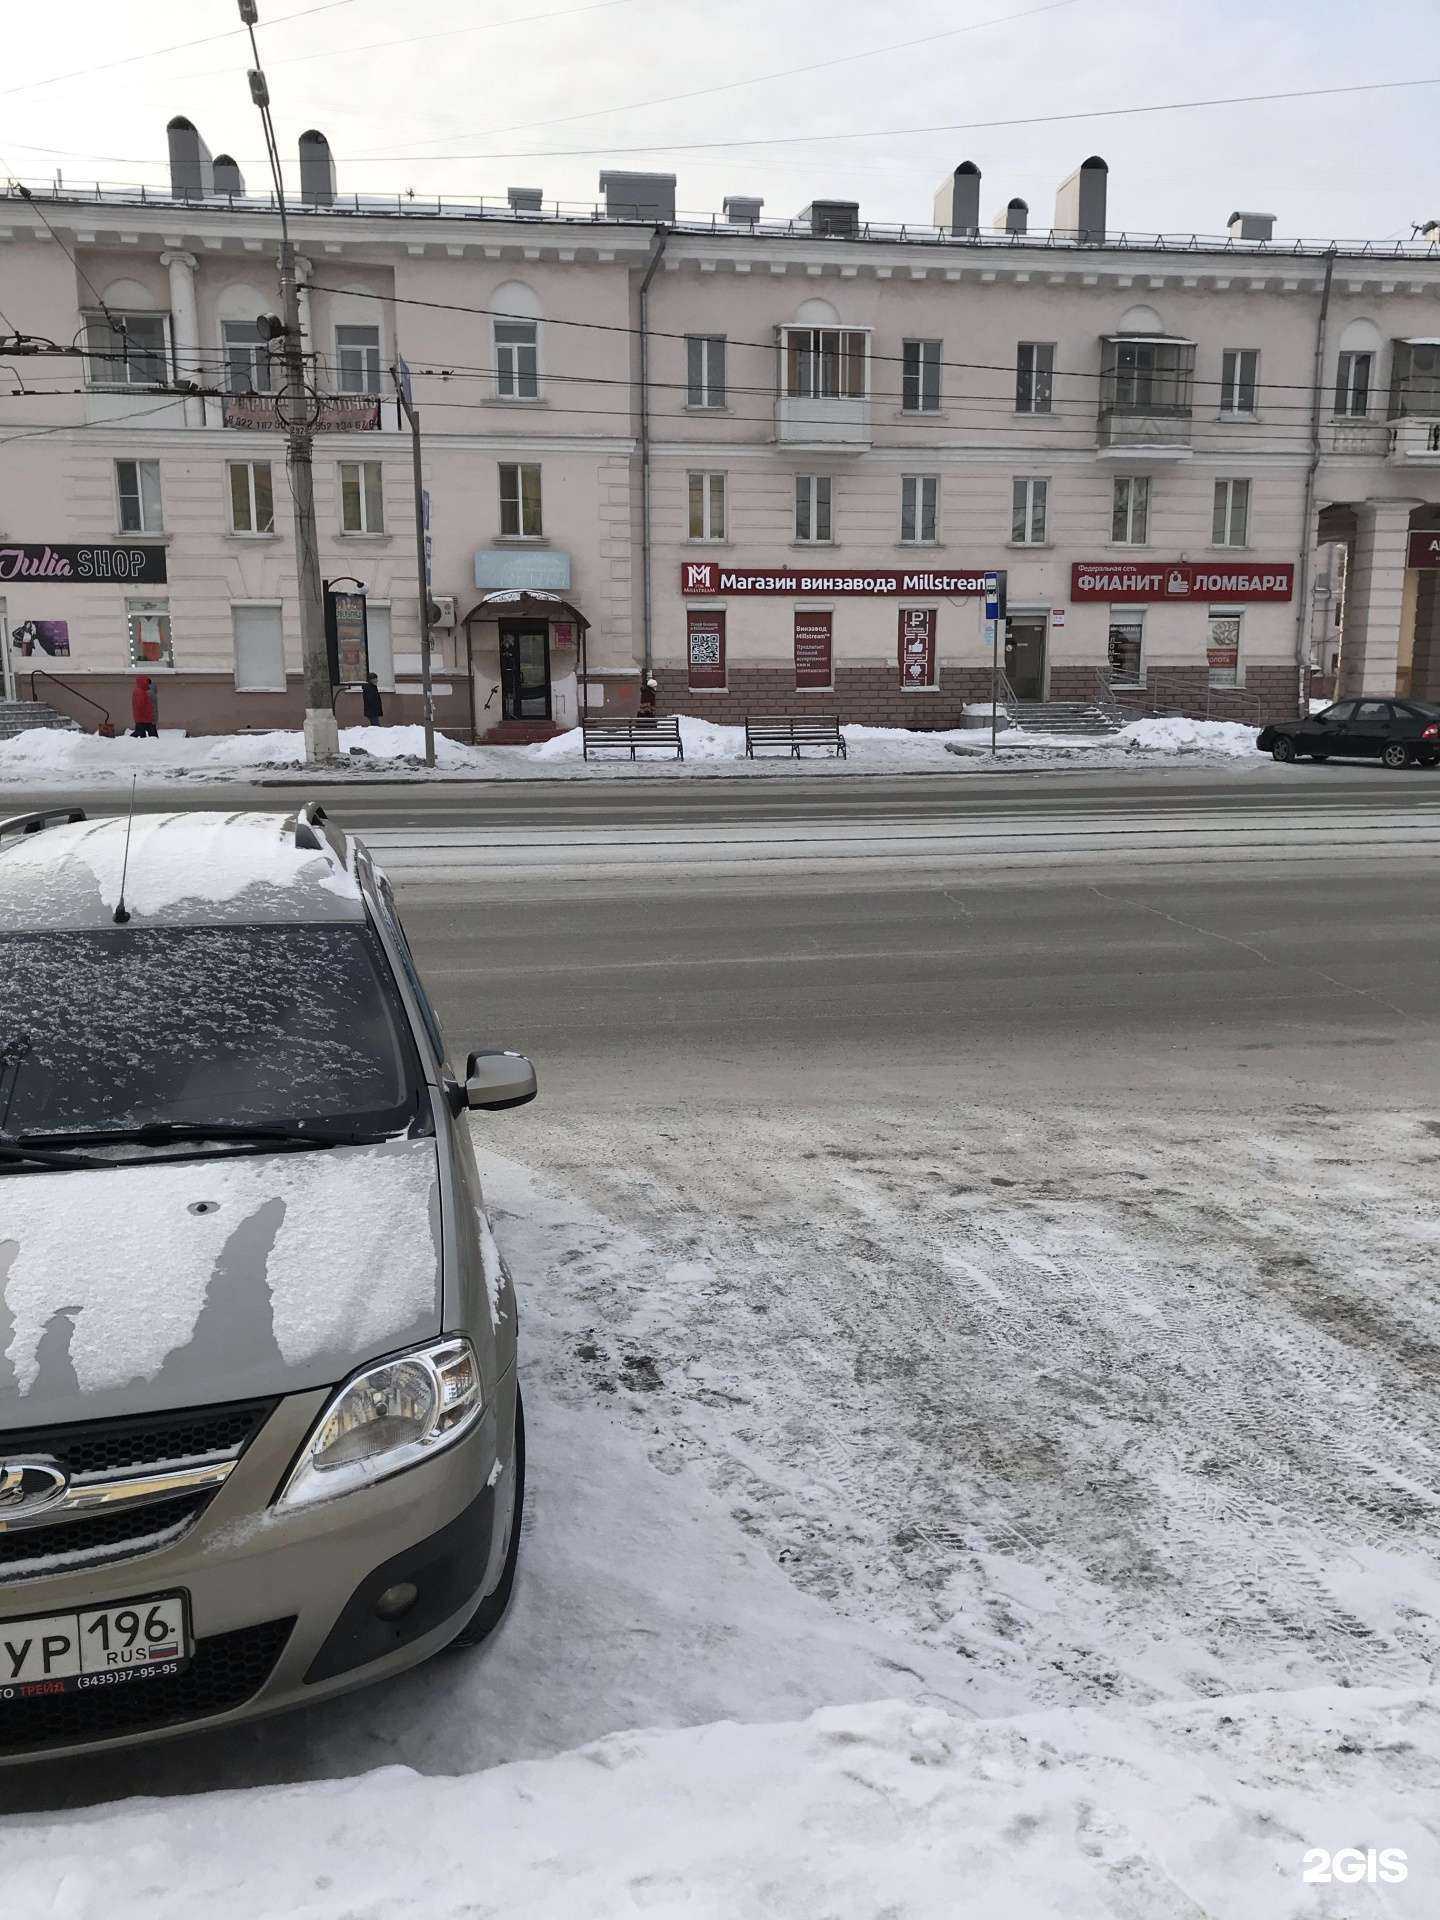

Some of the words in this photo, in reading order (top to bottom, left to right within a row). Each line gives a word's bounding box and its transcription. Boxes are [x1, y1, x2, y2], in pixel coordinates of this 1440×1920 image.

[0, 546, 73, 578] Julia
[77, 549, 145, 577] SHOP
[1078, 564, 1121, 572] Федеральная
[720, 574, 796, 590] Магазин
[801, 577, 897, 593] винзавода
[1078, 575, 1163, 591] ФИАНИТ
[1193, 575, 1288, 591] ЛОМБАРД
[87, 1605, 169, 1651] 196
[106, 1648, 147, 1665] RUS
[20, 1682, 65, 1697] ТРЕЙД
[77, 1662, 178, 1690] (3435)37-95-95
